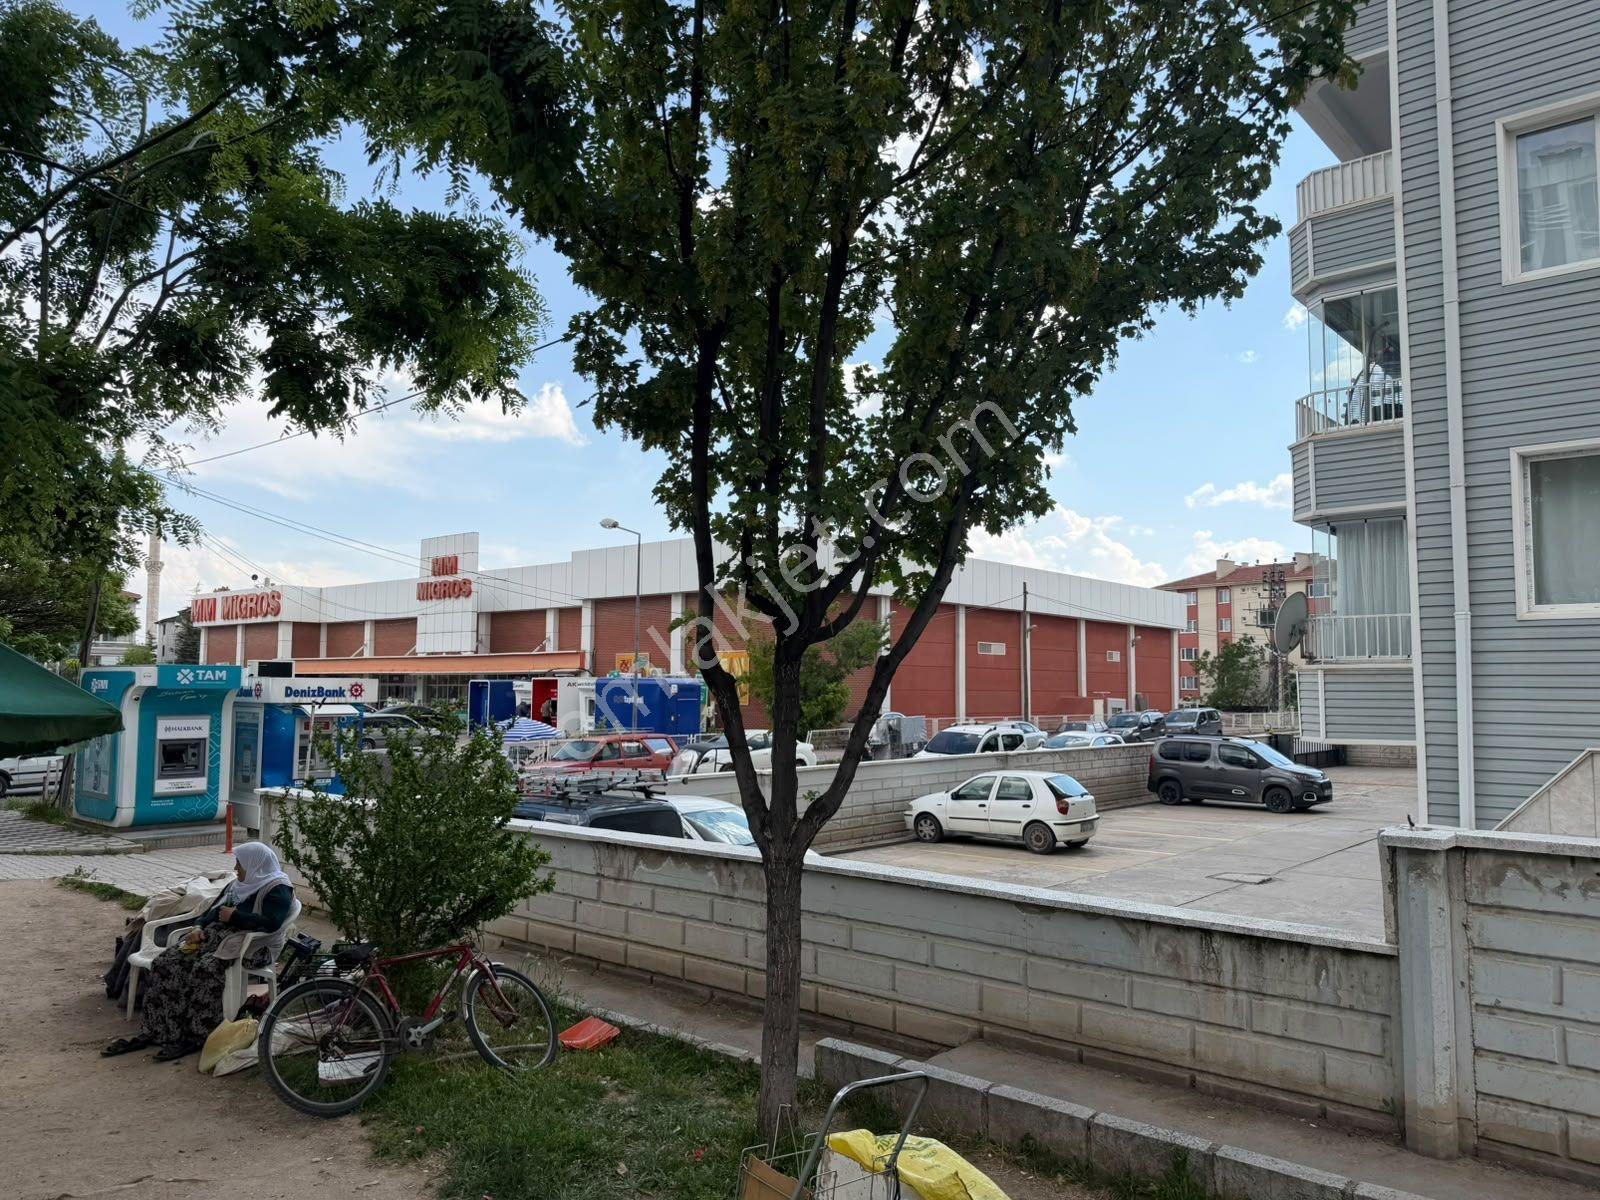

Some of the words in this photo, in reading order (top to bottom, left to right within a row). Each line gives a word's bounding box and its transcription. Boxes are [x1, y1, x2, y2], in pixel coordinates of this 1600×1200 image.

[191, 597, 216, 622] MM
[196, 670, 227, 681] TAM
[284, 686, 346, 698] DenizBank
